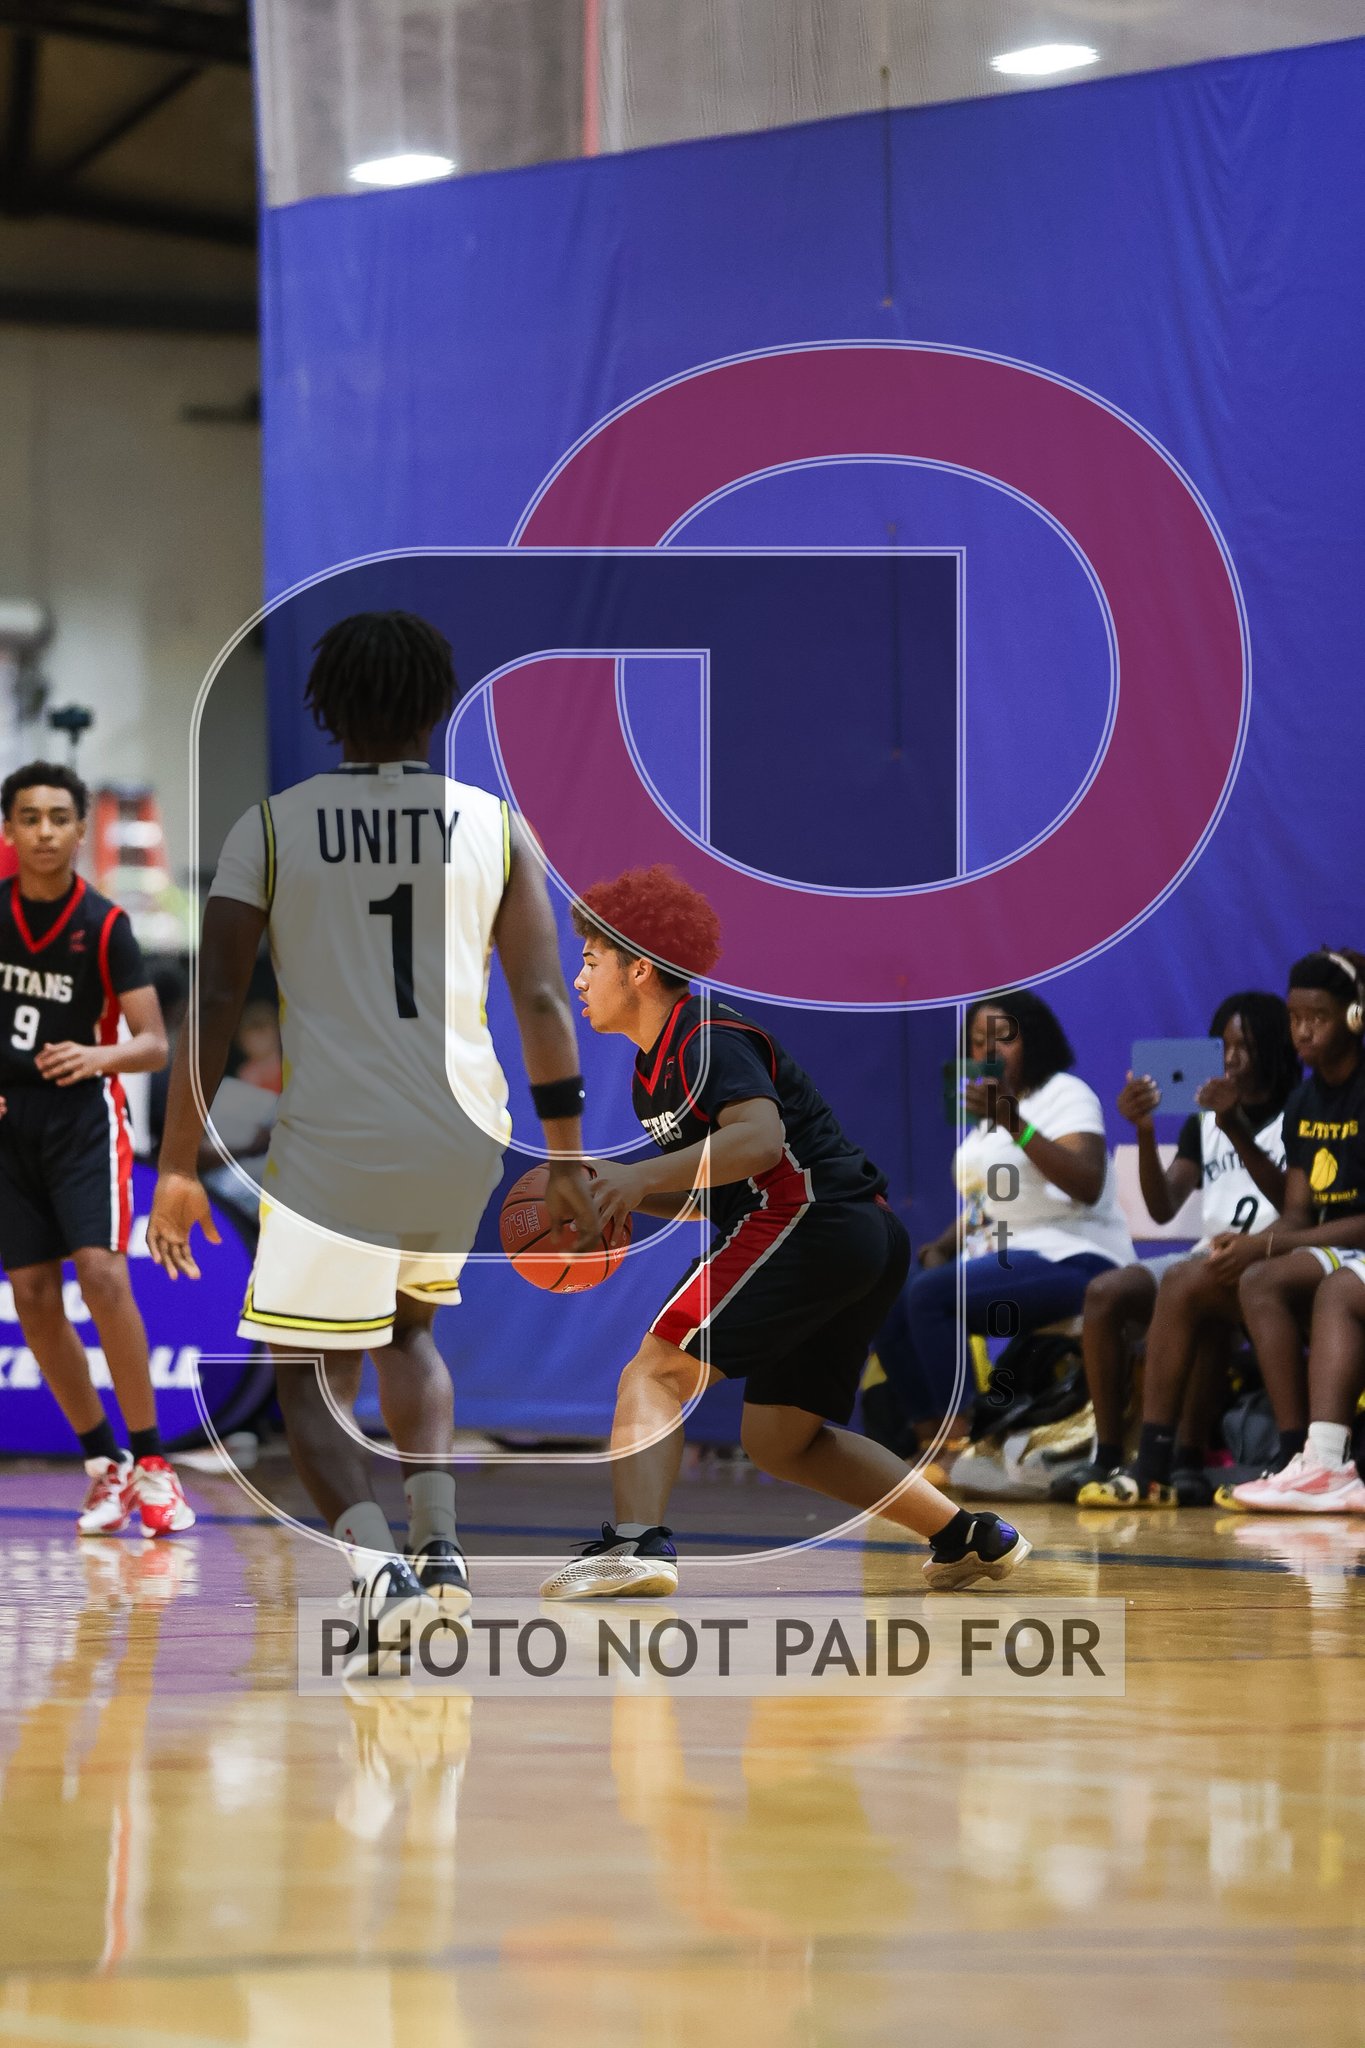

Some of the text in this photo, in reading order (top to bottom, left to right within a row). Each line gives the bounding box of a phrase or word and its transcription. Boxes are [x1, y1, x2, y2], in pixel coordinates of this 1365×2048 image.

[317, 808, 460, 864] UNITY
[369, 884, 419, 1018] 1
[0, 962, 73, 1003] ITANS
[11, 1005, 40, 1051] 9
